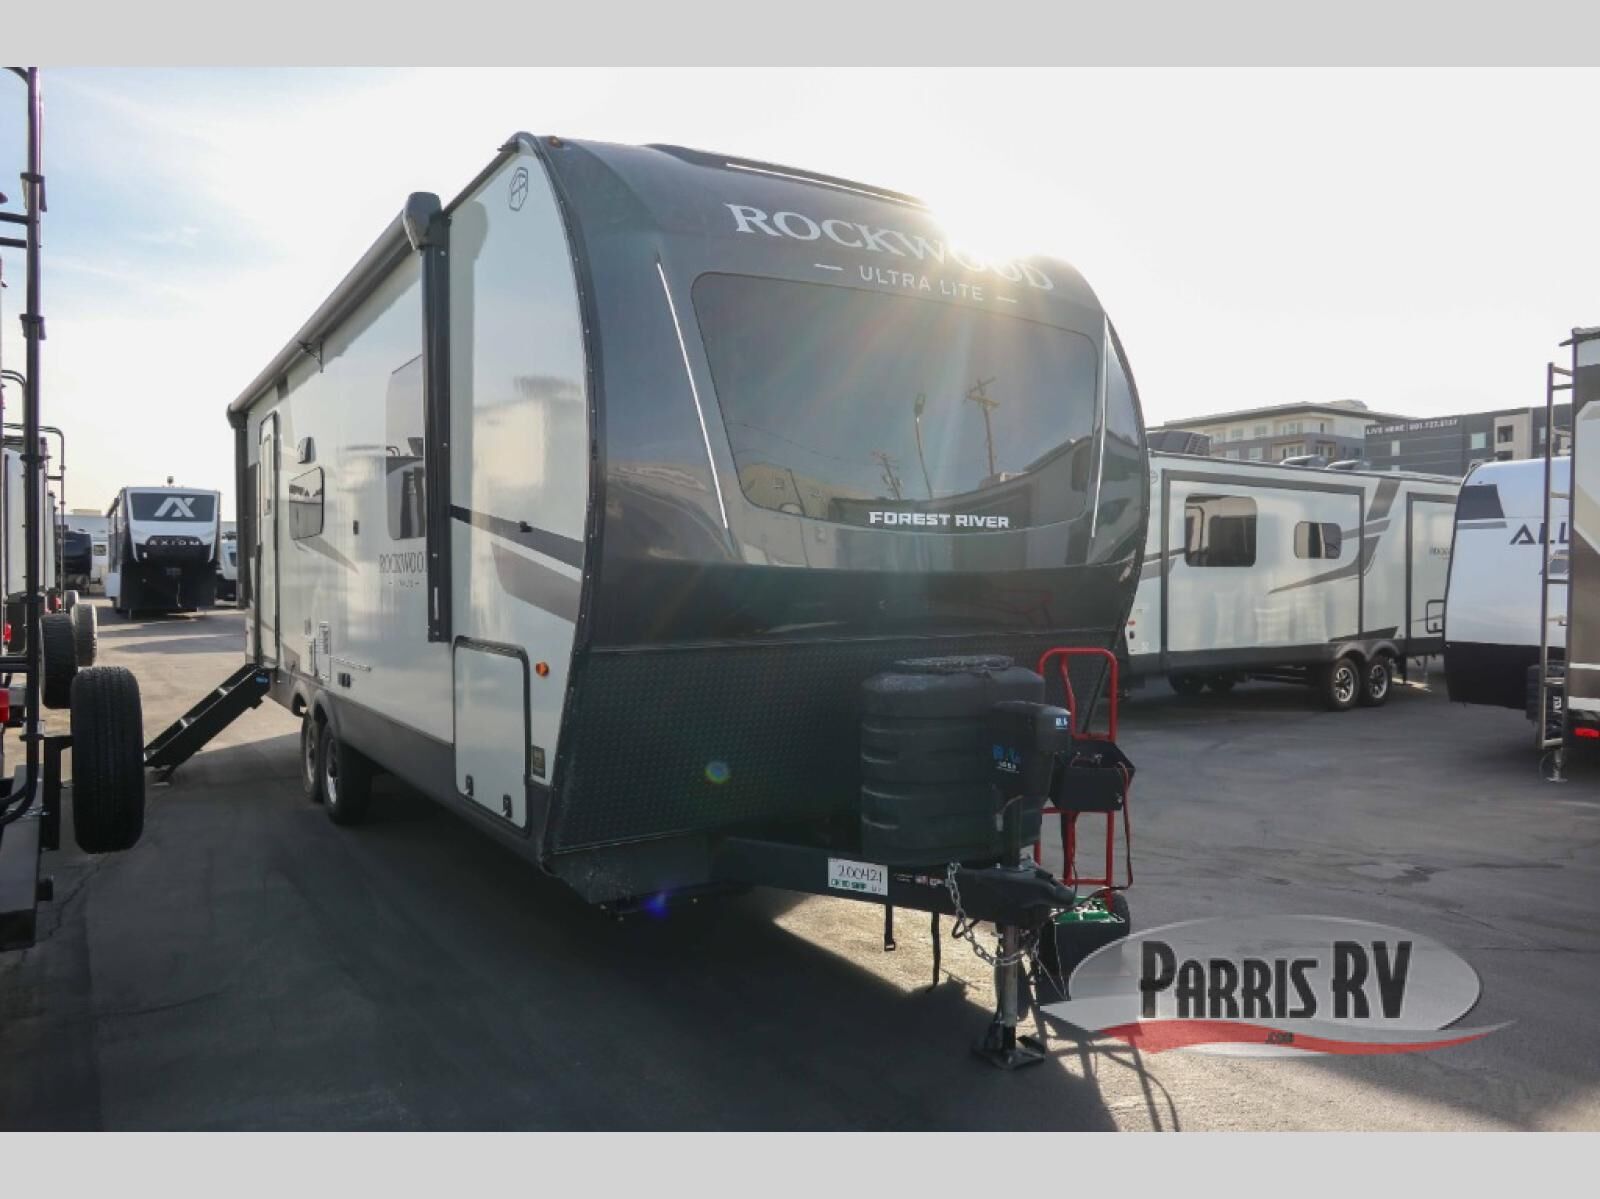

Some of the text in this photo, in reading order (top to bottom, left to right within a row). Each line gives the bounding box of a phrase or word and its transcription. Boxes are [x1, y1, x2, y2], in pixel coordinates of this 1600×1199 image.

[858, 264, 984, 302] ULTRA LITE
[868, 511, 1009, 529] FOREST RIVER
[379, 551, 427, 574] ROCKWOO
